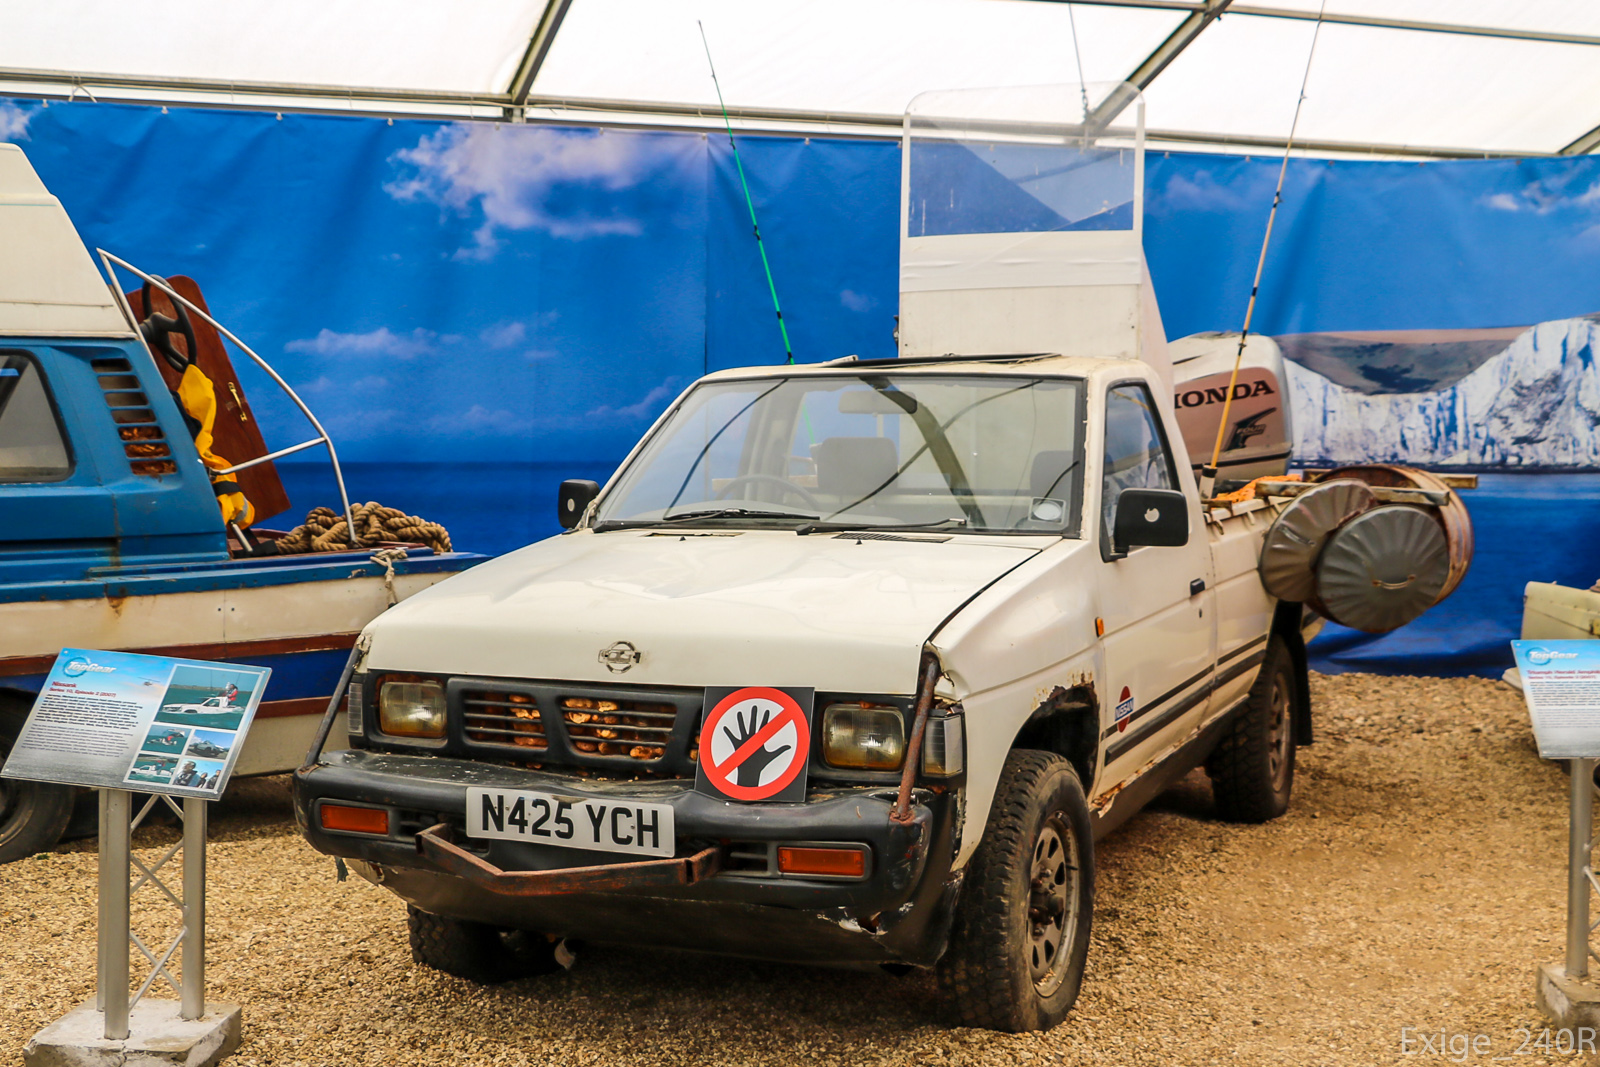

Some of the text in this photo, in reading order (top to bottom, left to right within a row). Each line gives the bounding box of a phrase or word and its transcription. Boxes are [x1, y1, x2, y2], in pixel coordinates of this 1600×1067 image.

[67, 661, 117, 673] TopGear
[1114, 699, 1134, 720] NISSAN
[482, 794, 659, 848] N425 YCH
